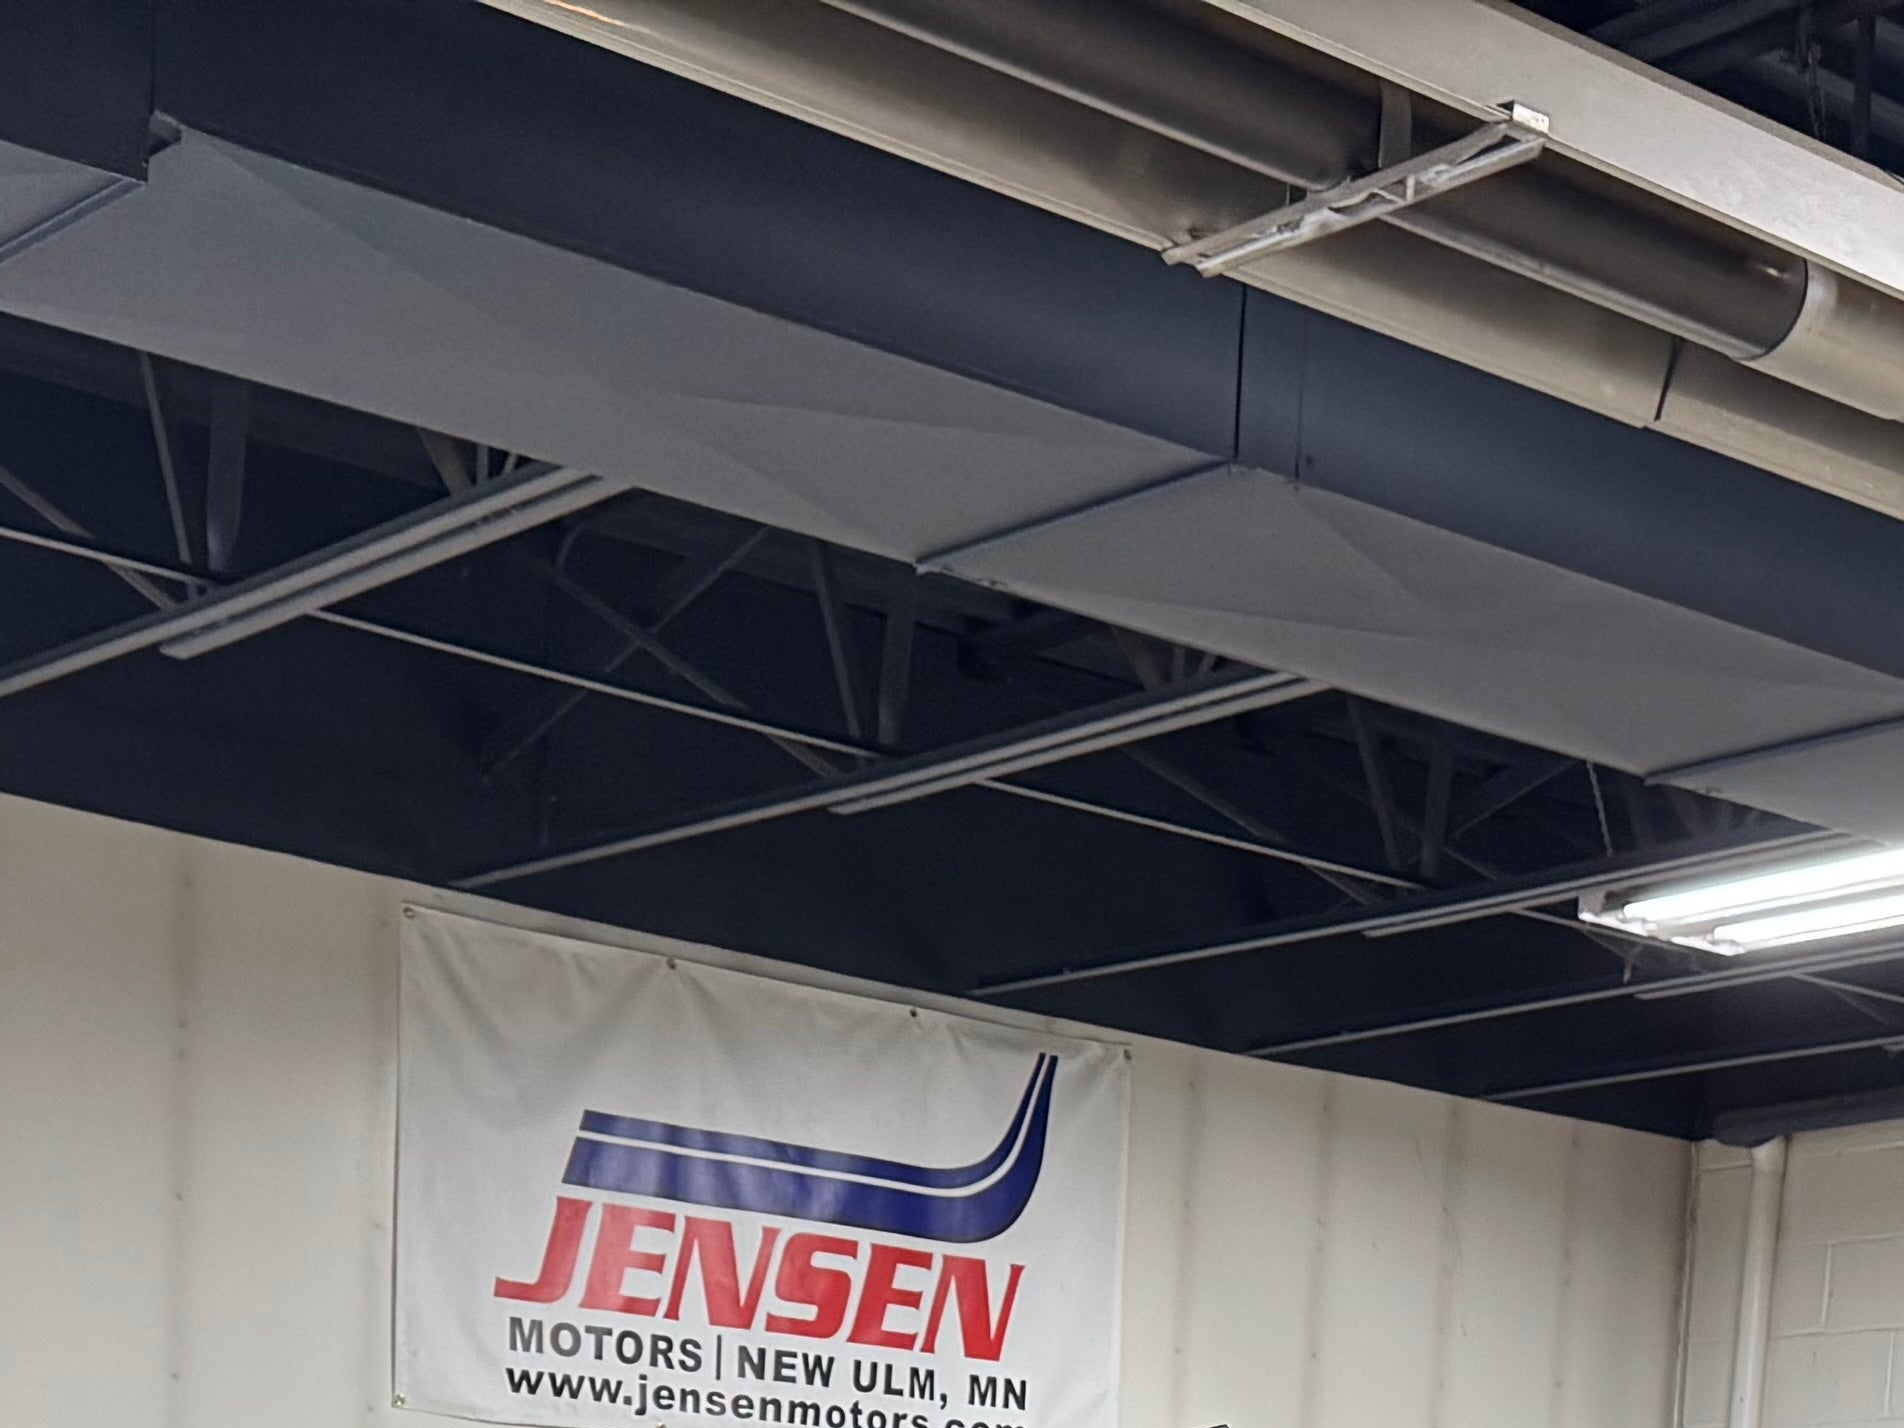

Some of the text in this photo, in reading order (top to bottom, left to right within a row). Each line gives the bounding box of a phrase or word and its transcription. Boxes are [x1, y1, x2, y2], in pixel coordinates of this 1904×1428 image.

[492, 1195, 1026, 1362] JENSEN
[508, 1316, 1028, 1411] MOTORS NEW ULM, MN
